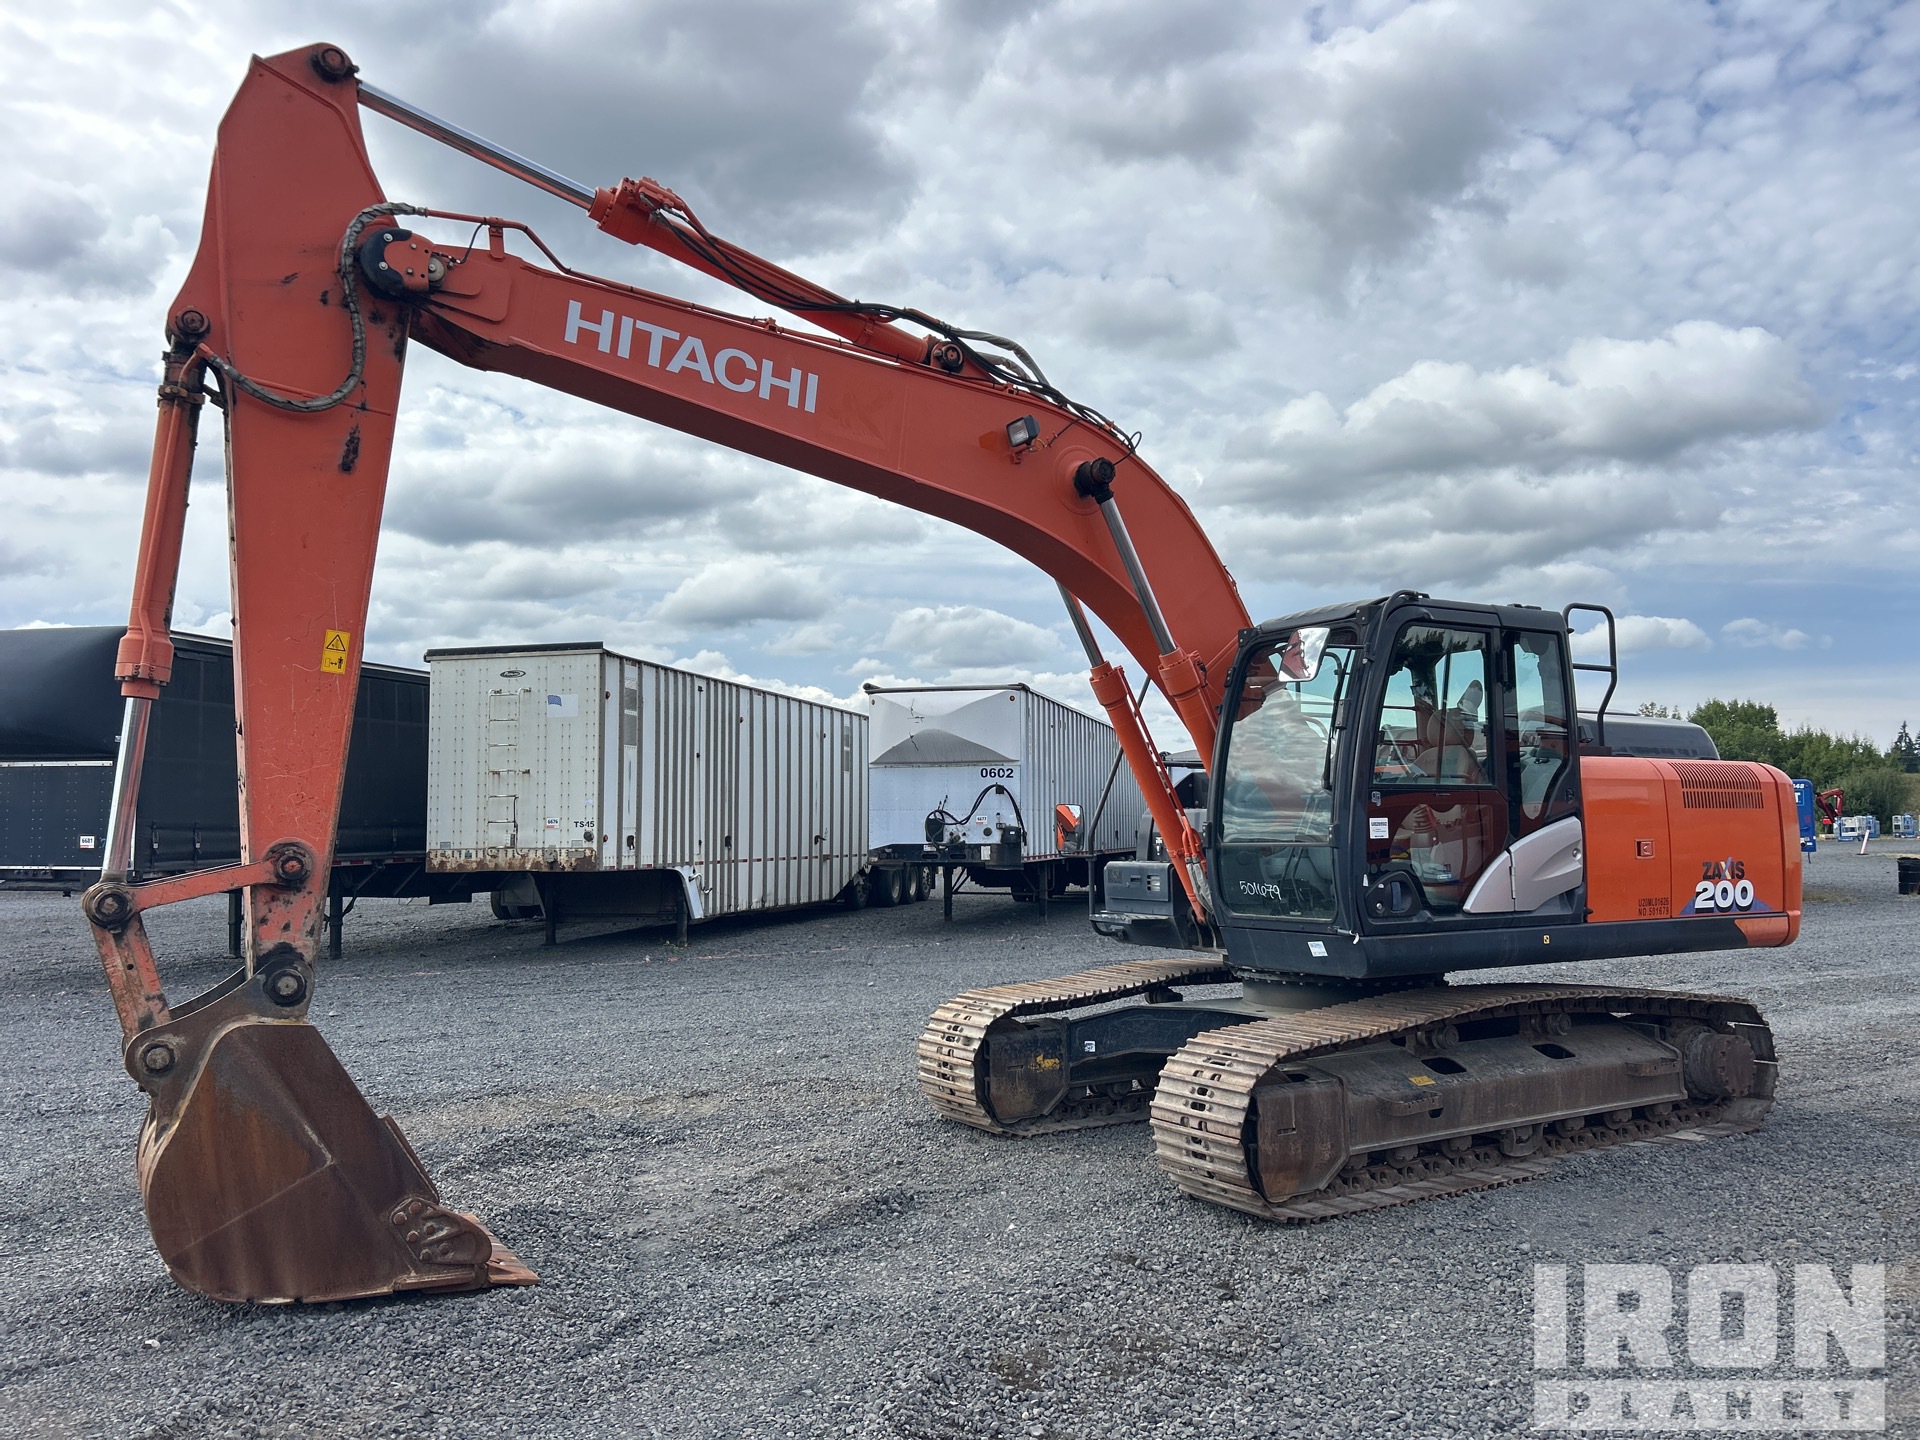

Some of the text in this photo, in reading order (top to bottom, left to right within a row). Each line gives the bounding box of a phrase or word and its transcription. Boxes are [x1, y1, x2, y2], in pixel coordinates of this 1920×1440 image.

[564, 299, 819, 414] HITACHI
[980, 767, 1014, 778] 0602
[1702, 856, 1745, 880] ZAXIS
[1694, 879, 1755, 913] 200
